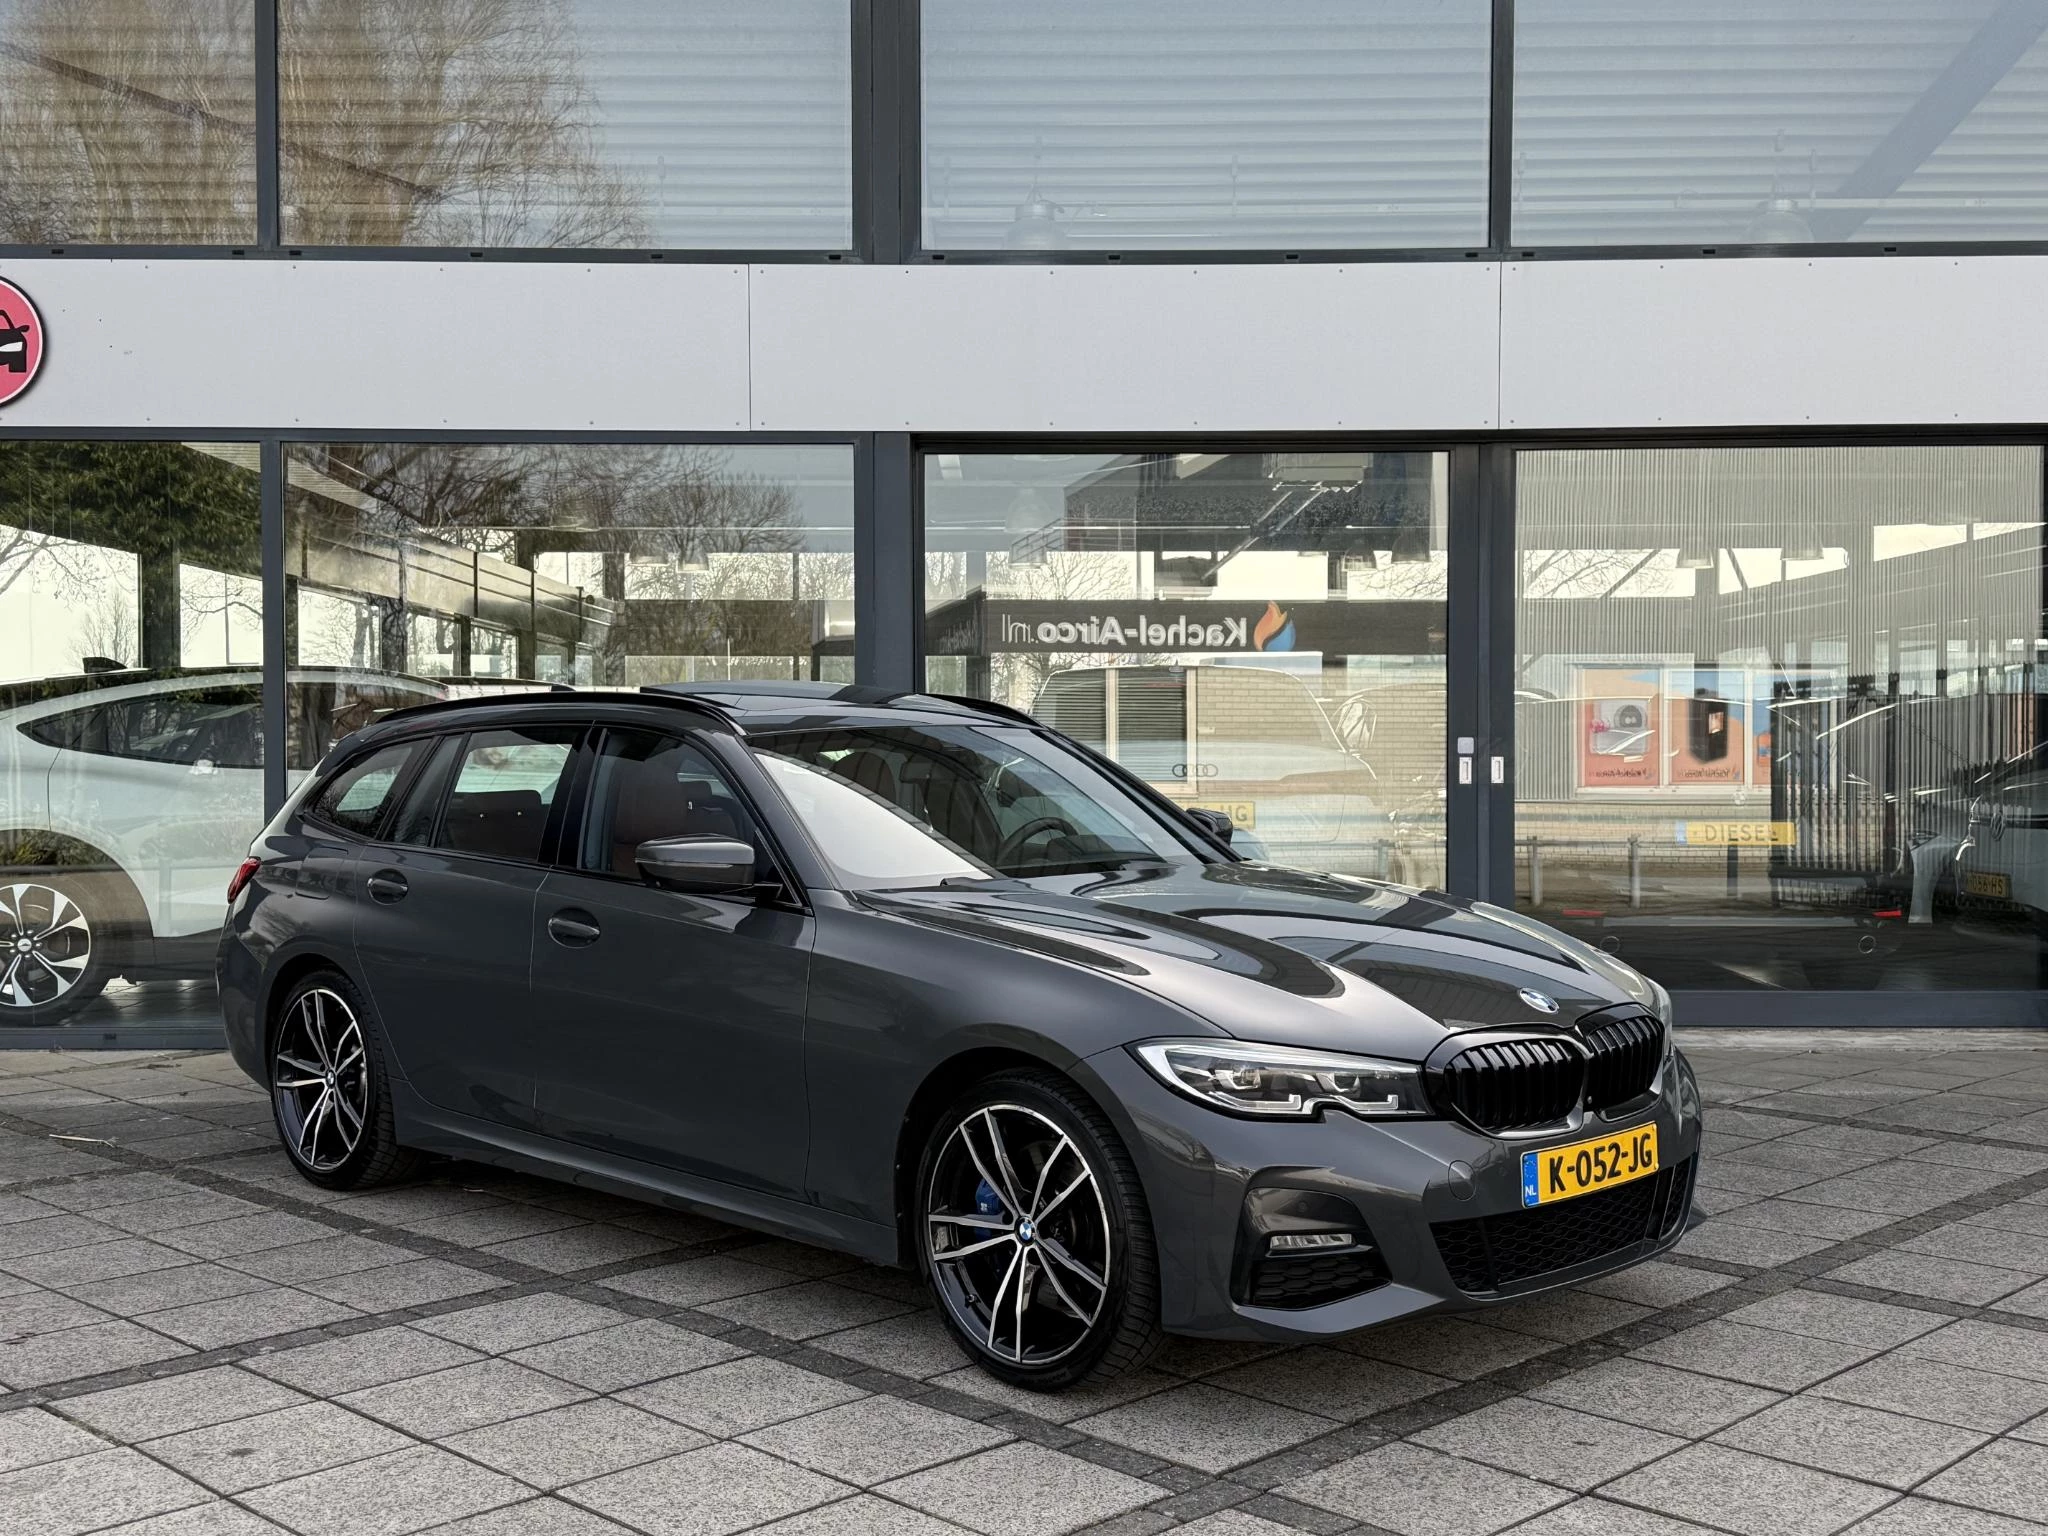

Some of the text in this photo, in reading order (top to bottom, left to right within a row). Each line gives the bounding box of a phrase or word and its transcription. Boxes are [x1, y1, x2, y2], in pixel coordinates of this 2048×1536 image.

[1704, 824, 1779, 842] DIESEL
[1525, 1133, 1652, 1196] NL K-052-JG
